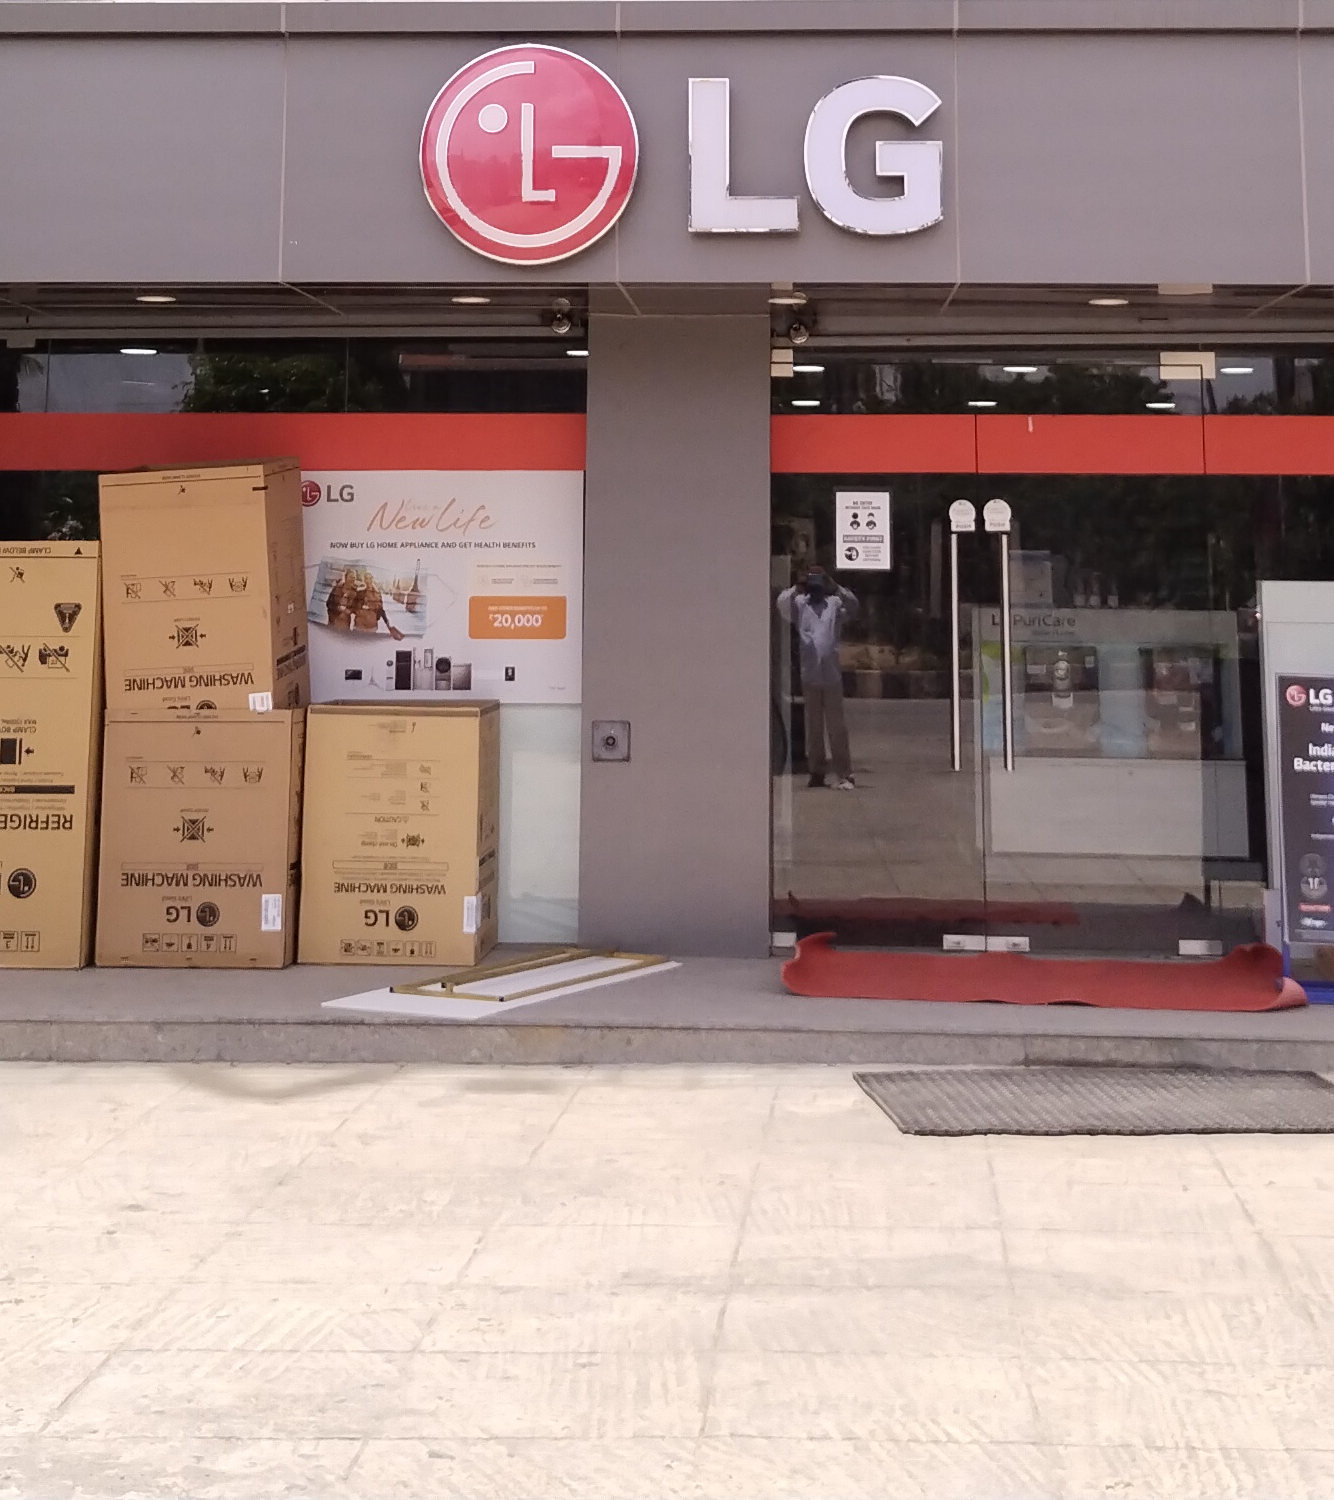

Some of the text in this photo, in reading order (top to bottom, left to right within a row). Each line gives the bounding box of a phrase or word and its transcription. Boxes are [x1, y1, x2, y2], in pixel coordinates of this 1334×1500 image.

[685, 73, 947, 236] LG
[326, 484, 355, 503] LG
[1013, 613, 1076, 628] PuriCare
[123, 671, 255, 692] WASHING MACHINE
[1309, 688, 1334, 705] LG
[120, 872, 263, 888] WASHING MACHINE
[333, 881, 447, 895] WASHING MACHINE
[165, 905, 192, 923] LG
[363, 909, 390, 928] LG
